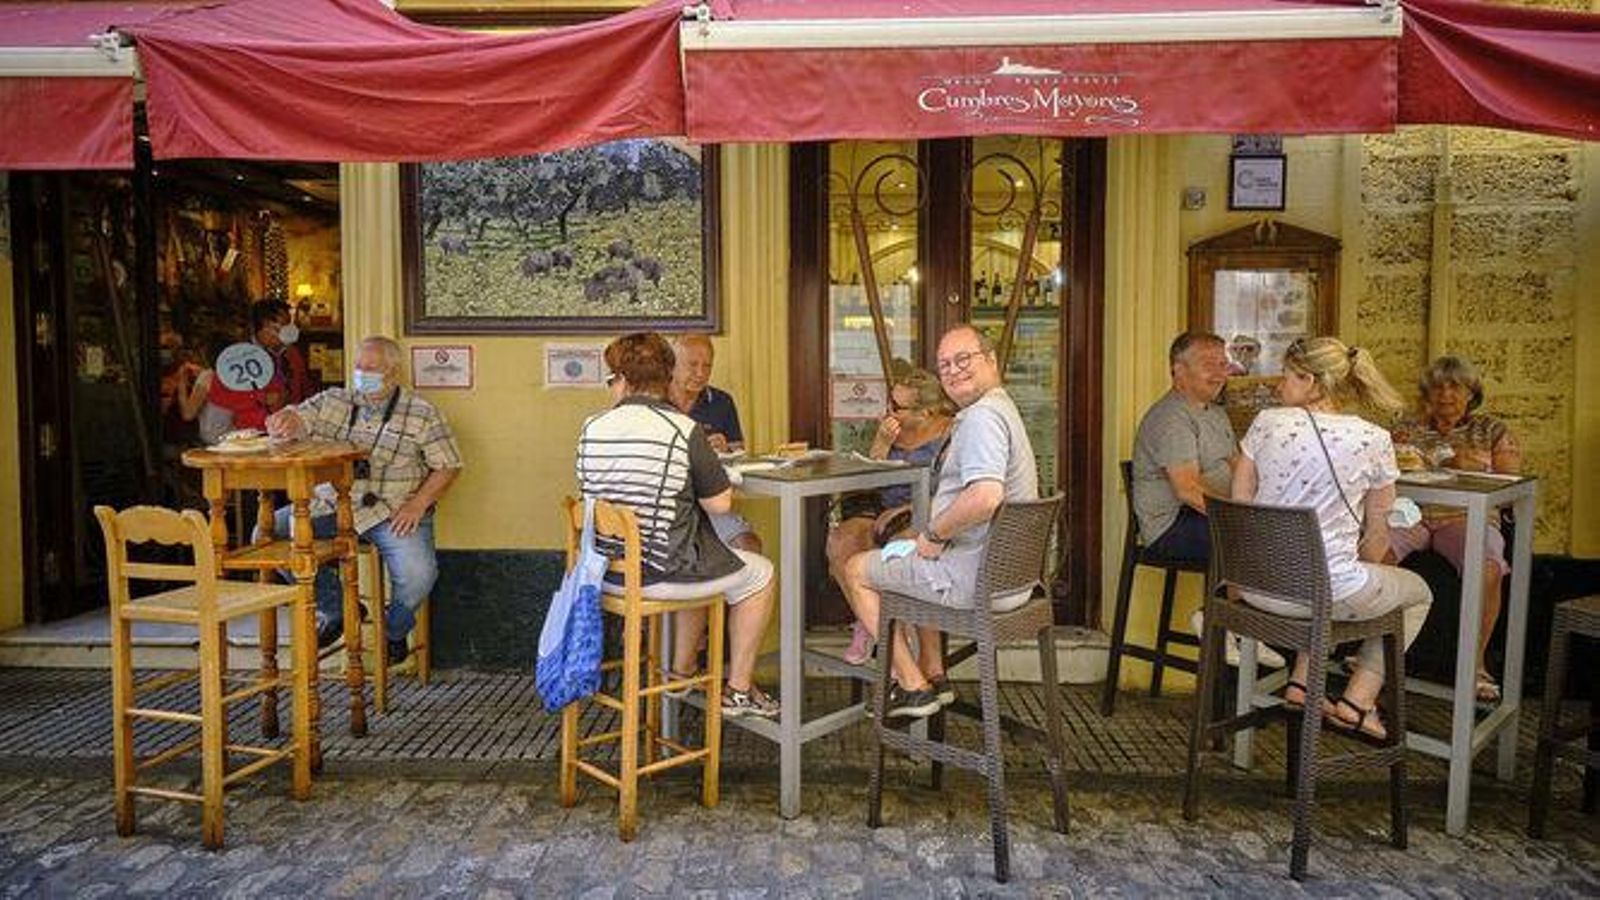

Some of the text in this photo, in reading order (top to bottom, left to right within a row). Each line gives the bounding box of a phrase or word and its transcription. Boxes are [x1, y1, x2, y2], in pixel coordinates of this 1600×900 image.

[918, 87, 1138, 120] Cumbres Mayores
[229, 358, 263, 384] 20
